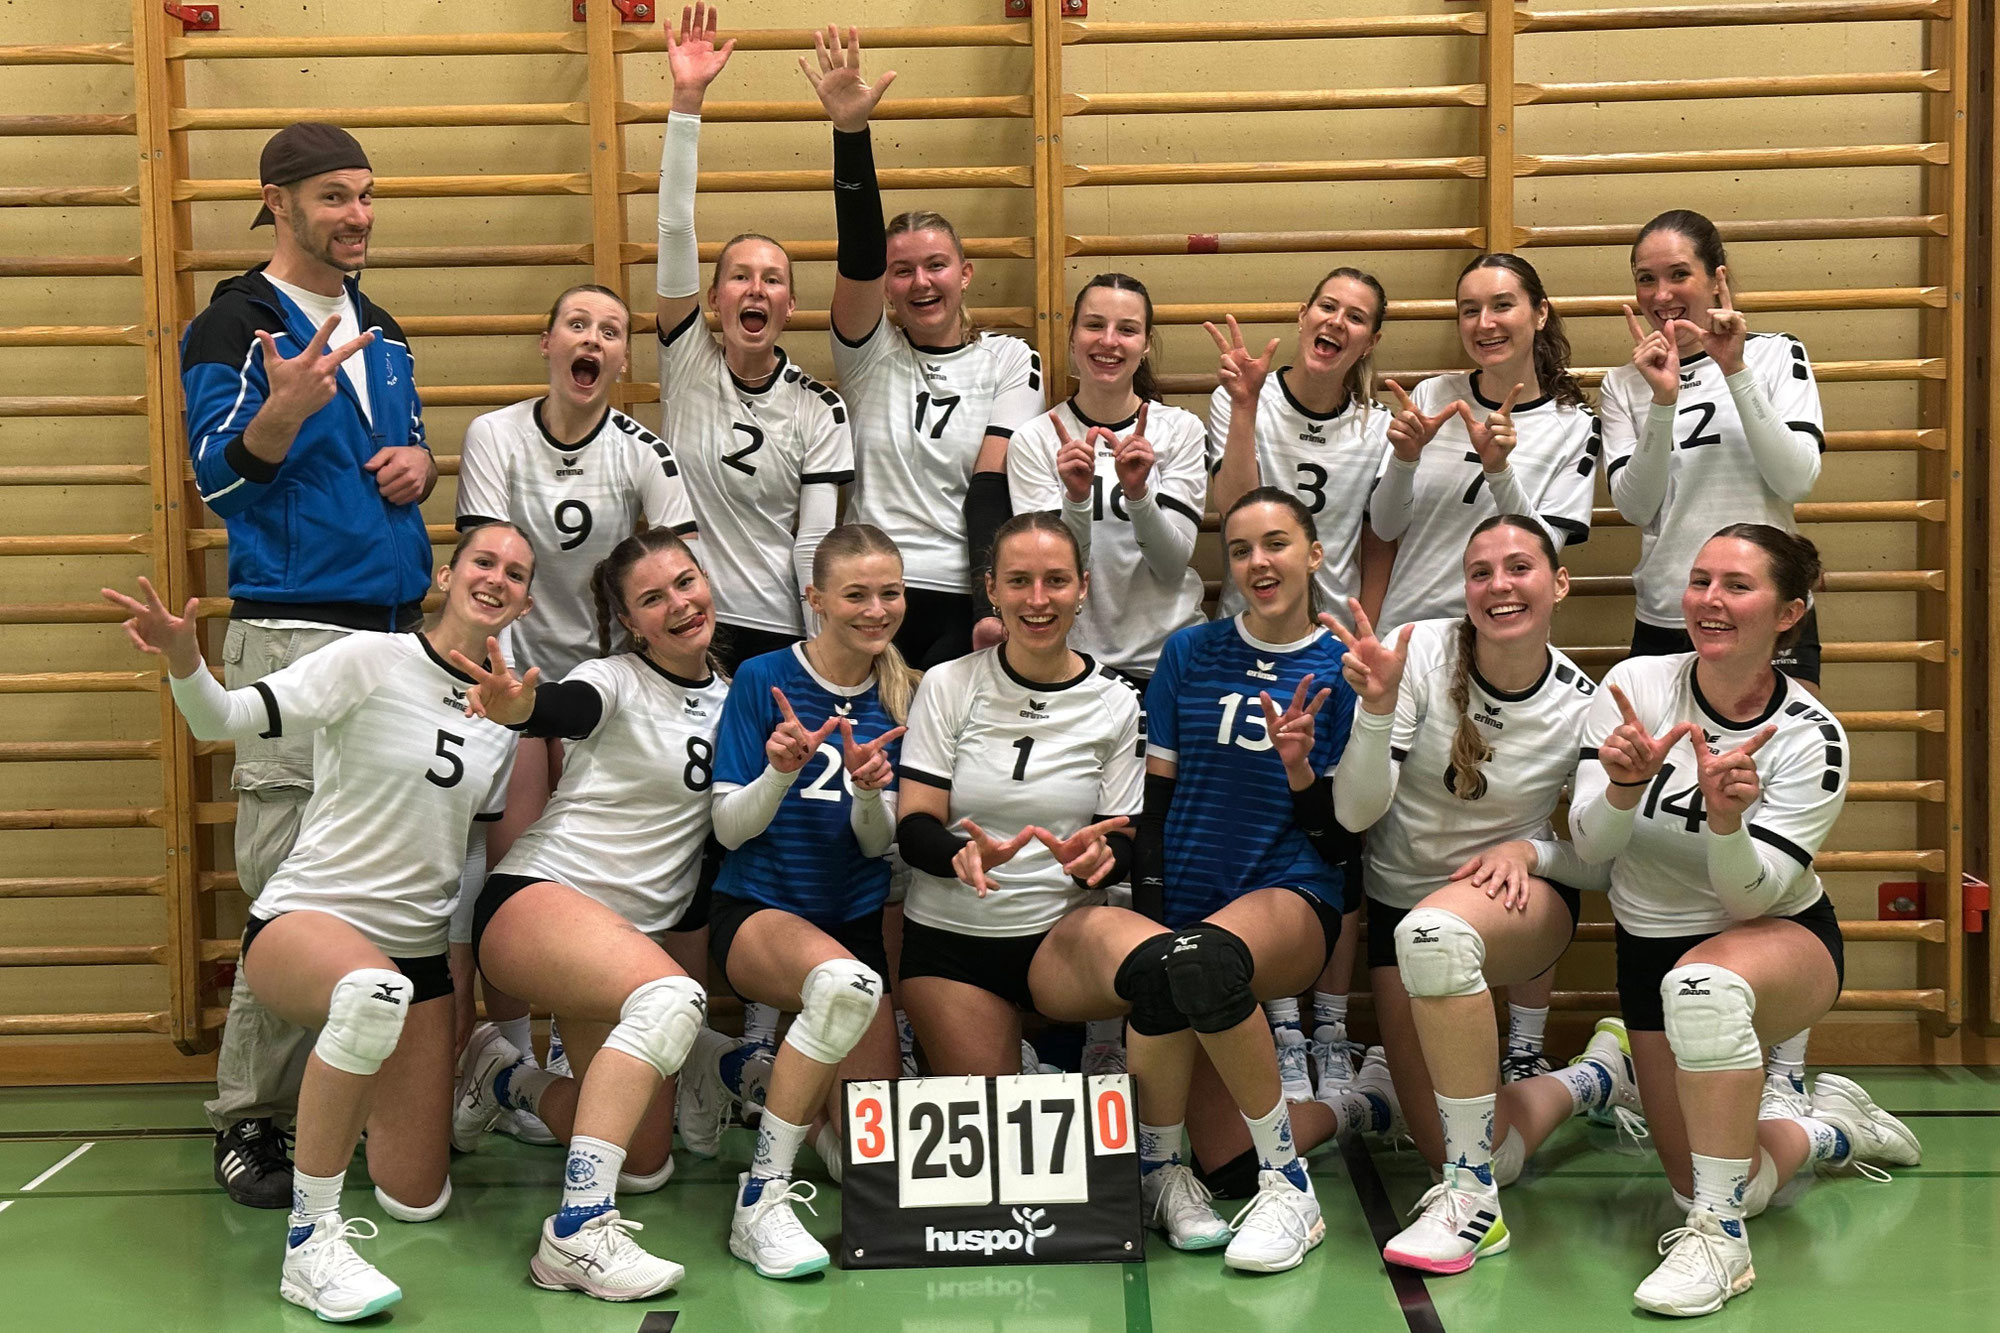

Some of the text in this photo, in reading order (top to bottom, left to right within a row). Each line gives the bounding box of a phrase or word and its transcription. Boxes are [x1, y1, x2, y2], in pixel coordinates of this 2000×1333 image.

[924, 373, 948, 381] rima
[1679, 380, 1702, 390] rima
[915, 391, 961, 439] 17
[1299, 433, 1326, 444] erima
[1671, 402, 1721, 452] 2
[556, 468, 584, 476] erima
[721, 422, 764, 477] 2
[1296, 463, 1329, 515] 3
[1462, 451, 1486, 505] 7
[554, 499, 593, 551] 9
[1217, 692, 1284, 752] 13
[1473, 713, 1504, 730] erima
[424, 728, 465, 788] 5
[683, 736, 712, 792] 8
[800, 742, 854, 802] 2
[1012, 735, 1035, 781] 1
[1643, 763, 1707, 834] 14
[855, 1097, 886, 1158] 3
[908, 1100, 984, 1180] 25
[1006, 1098, 1076, 1175] 17
[1097, 1090, 1128, 1150] 0
[570, 1150, 604, 1164] OLLEY
[925, 1226, 1024, 1256] huspo
